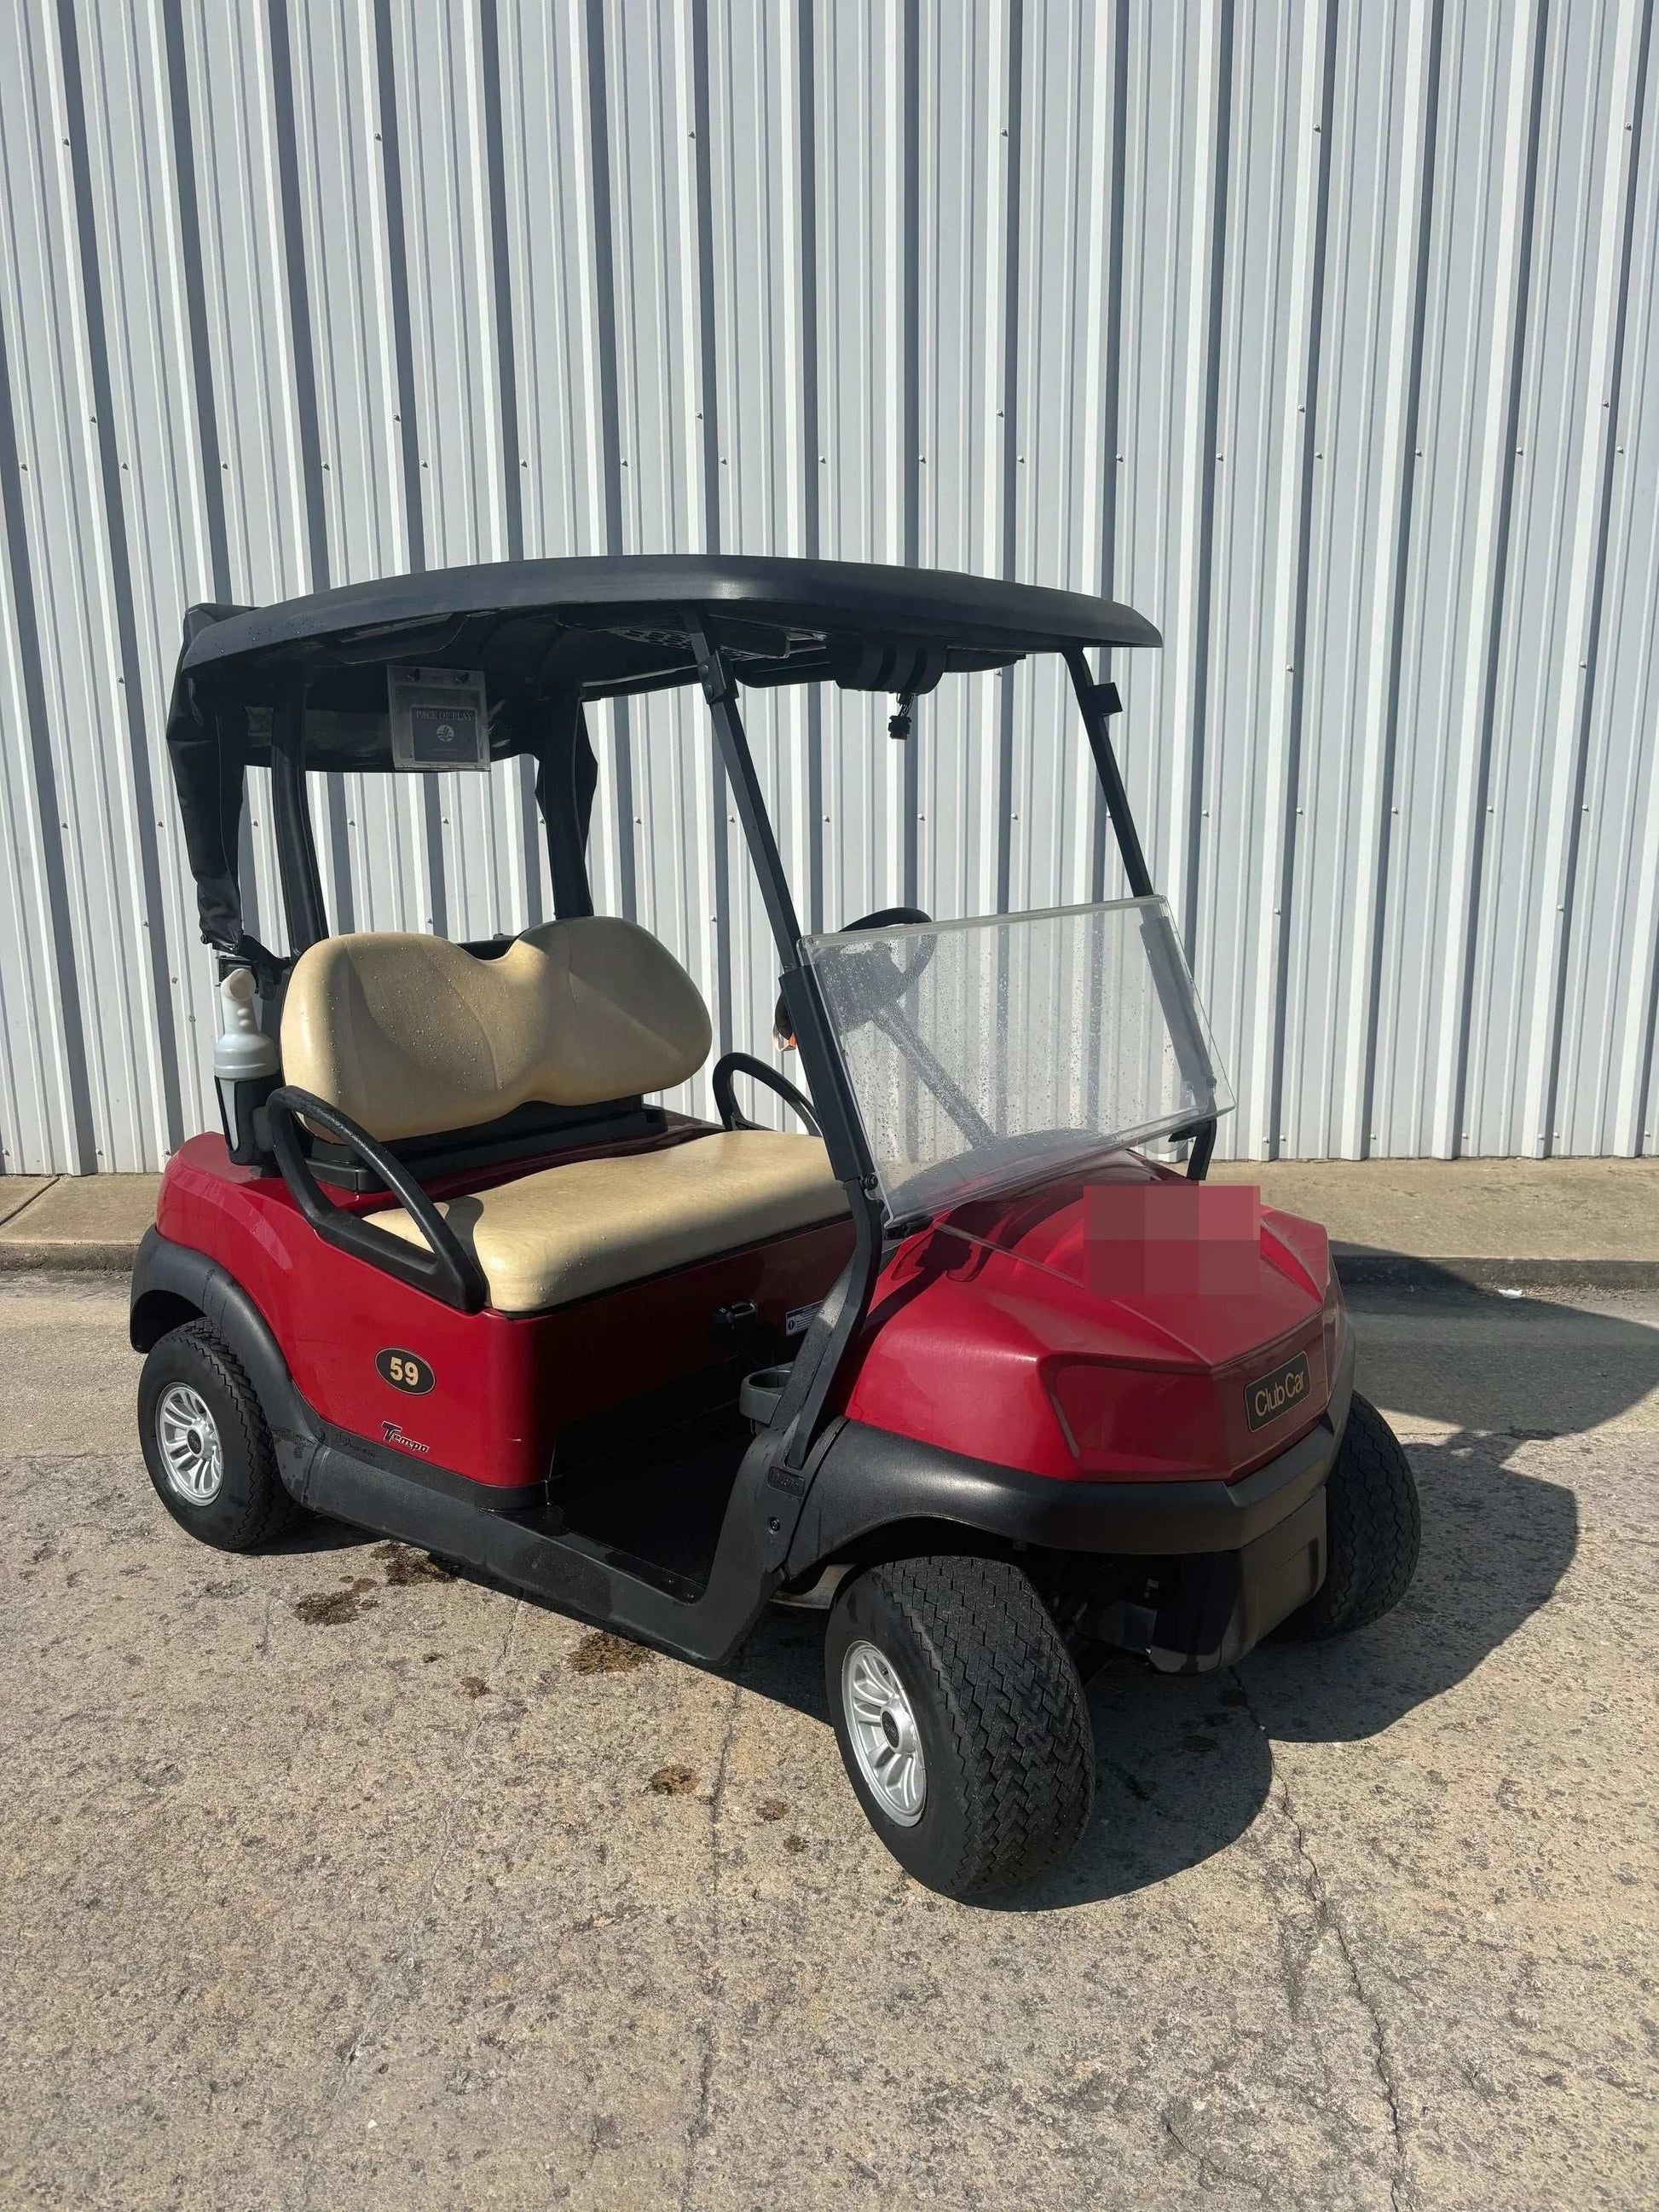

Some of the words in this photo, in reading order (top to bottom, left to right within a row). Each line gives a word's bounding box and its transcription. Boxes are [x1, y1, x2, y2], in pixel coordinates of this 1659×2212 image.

[416, 709, 437, 720] PACE
[452, 712, 471, 721] PLAY
[390, 1356, 419, 1386] 59
[1255, 1382, 1285, 1417] Club
[1285, 1371, 1304, 1398] Car
[381, 1420, 430, 1453] Tempo
